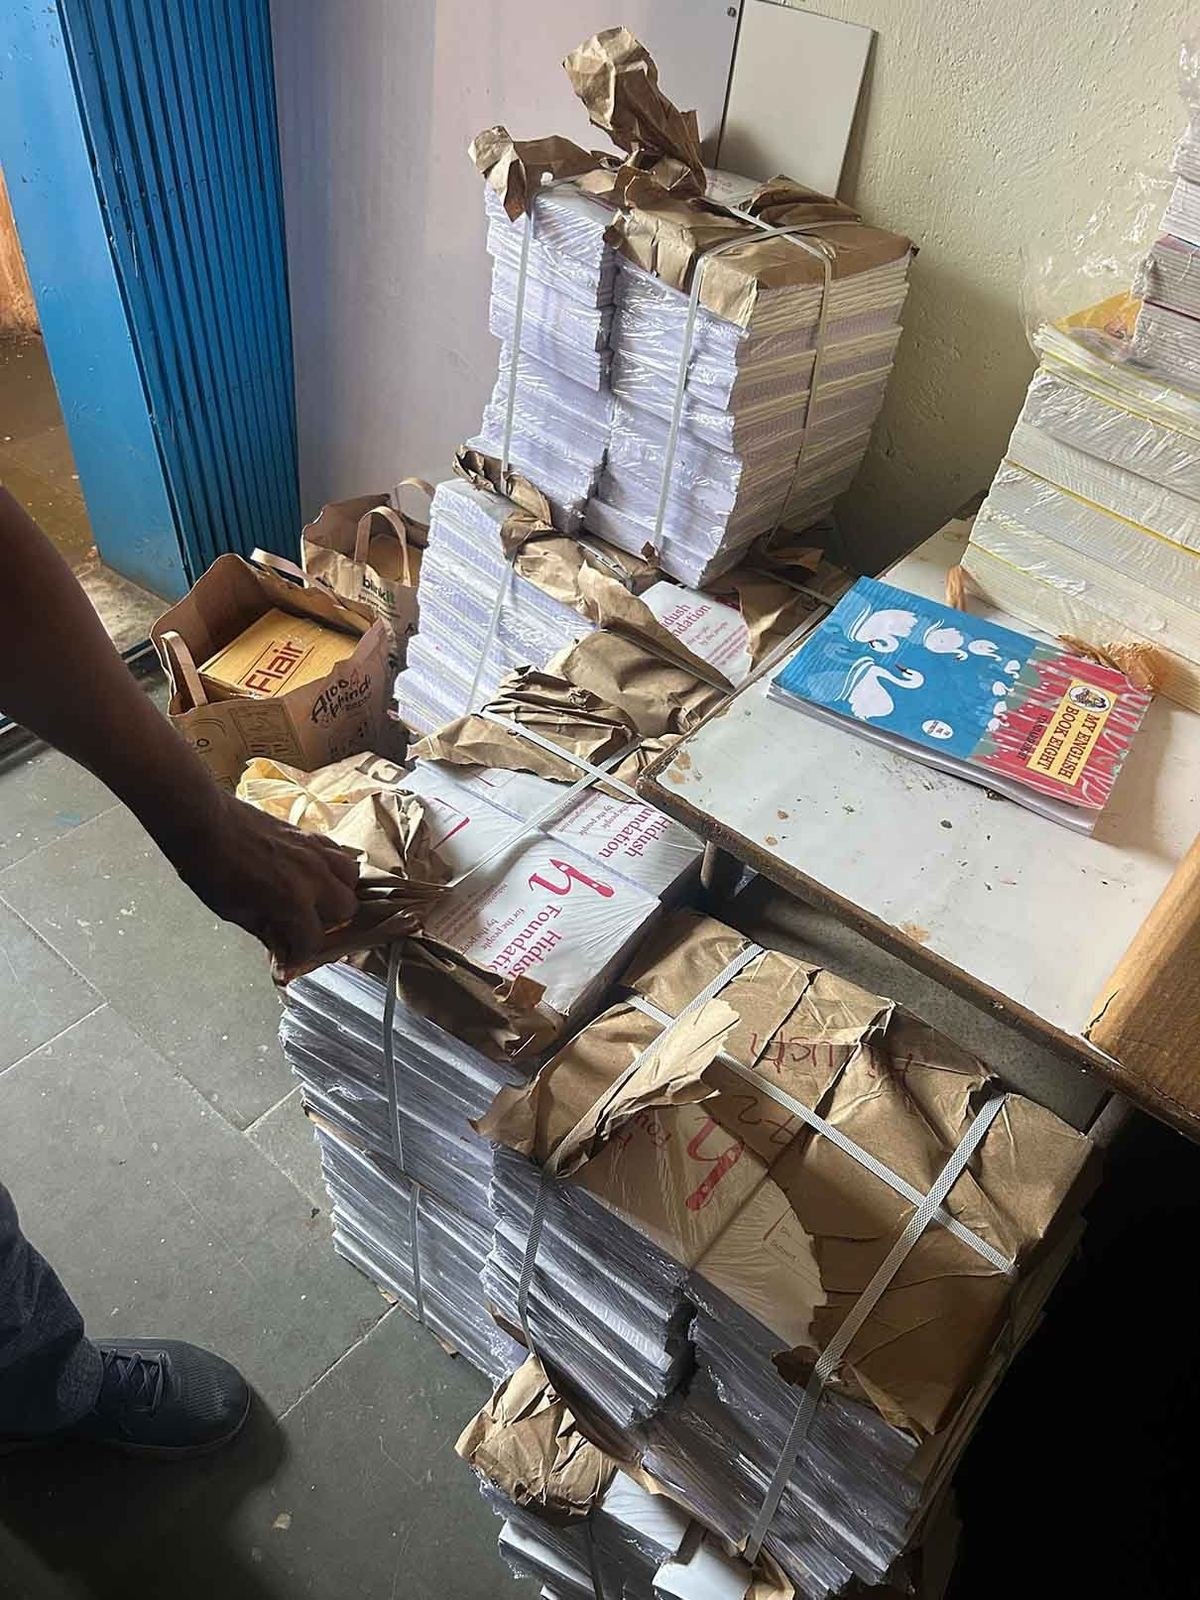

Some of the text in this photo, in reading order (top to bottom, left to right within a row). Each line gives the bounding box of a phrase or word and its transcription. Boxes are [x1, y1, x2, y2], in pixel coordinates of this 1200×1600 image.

[659, 603, 692, 628] idush
[672, 603, 711, 637] ndation
[245, 641, 304, 694] Flair
[1037, 705, 1080, 770] BOOK EIGHT
[1058, 713, 1101, 779] MY ENGLISH
[598, 807, 654, 858] undation
[624, 815, 673, 857] Hidush
[481, 927, 504, 950] people
[487, 918, 500, 927] by
[488, 904, 563, 972] Foundati
[501, 917, 515, 930] the
[460, 935, 478, 955] peop
